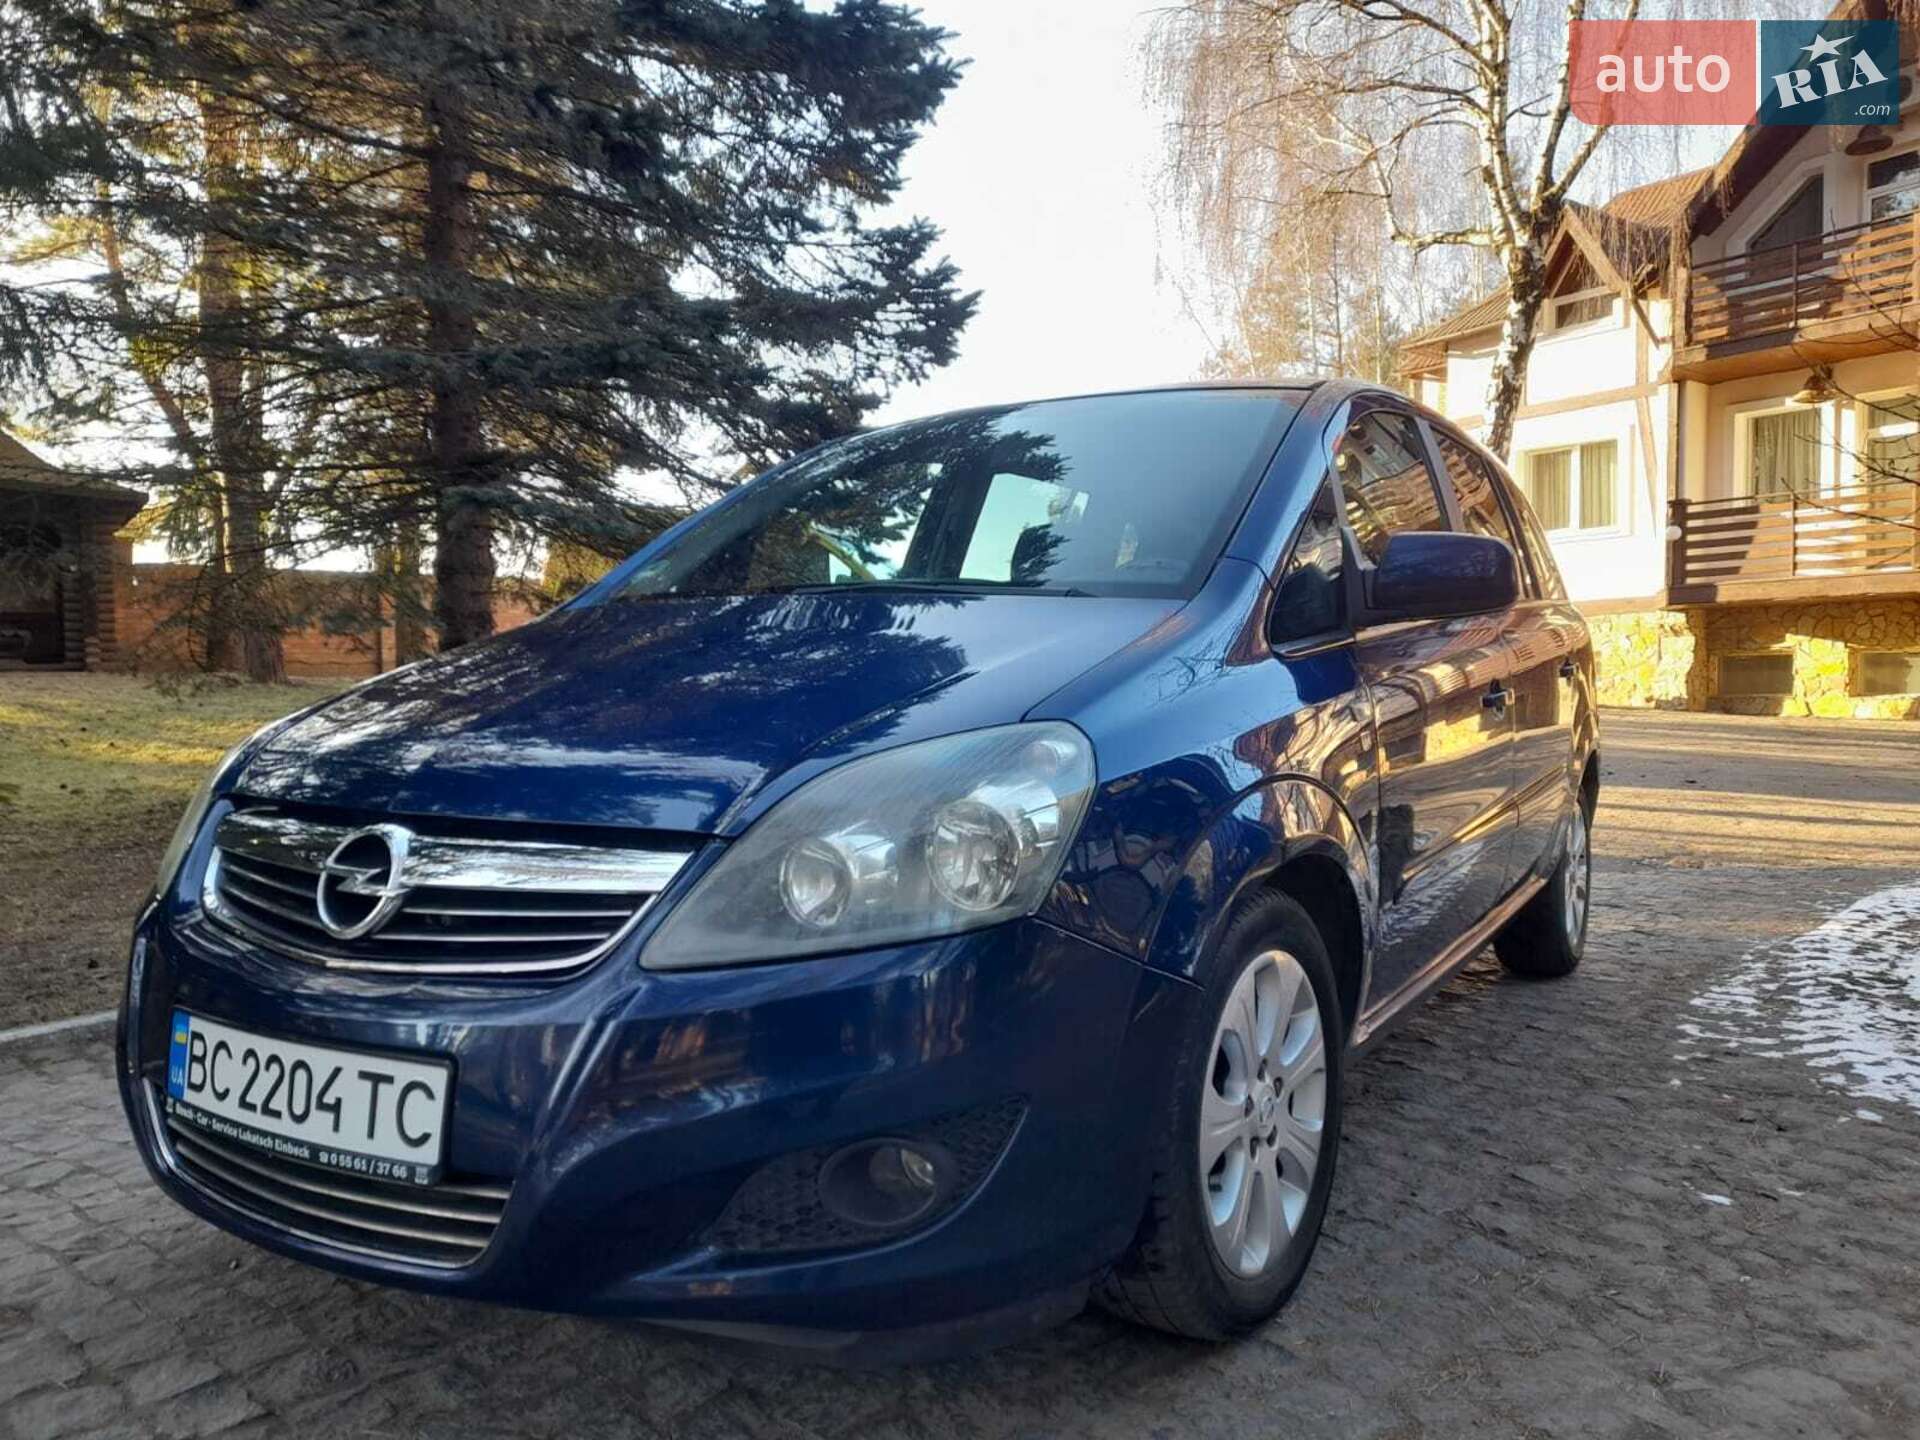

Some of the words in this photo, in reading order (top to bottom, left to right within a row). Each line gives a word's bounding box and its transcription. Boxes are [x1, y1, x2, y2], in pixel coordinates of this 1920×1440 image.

[170, 1067, 183, 1085] UA
[238, 1048, 343, 1133] 2204
[358, 1070, 435, 1148] TC
